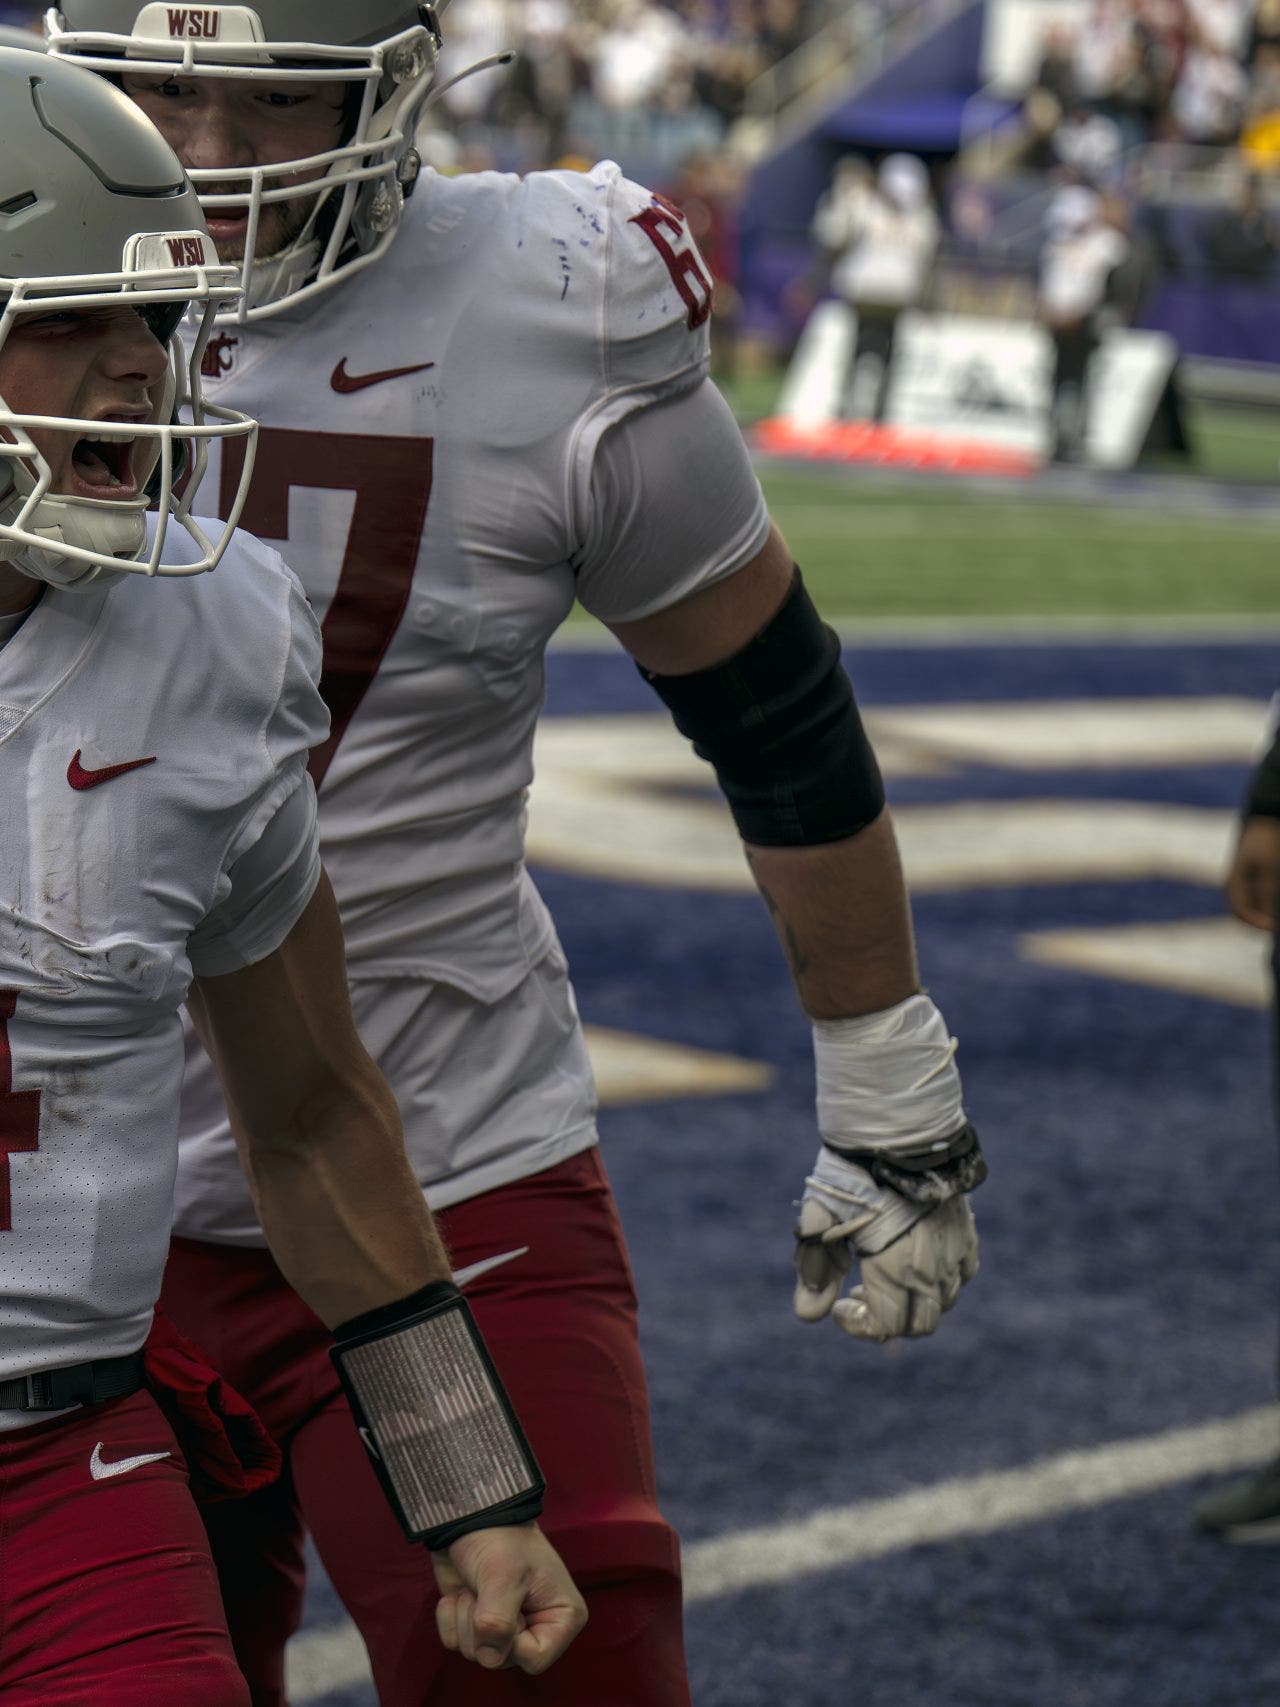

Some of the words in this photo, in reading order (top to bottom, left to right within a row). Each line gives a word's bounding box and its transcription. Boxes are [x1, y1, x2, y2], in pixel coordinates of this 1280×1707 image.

[166, 9, 219, 38] WSU
[166, 237, 206, 267] WSU
[627, 192, 715, 331] 6
